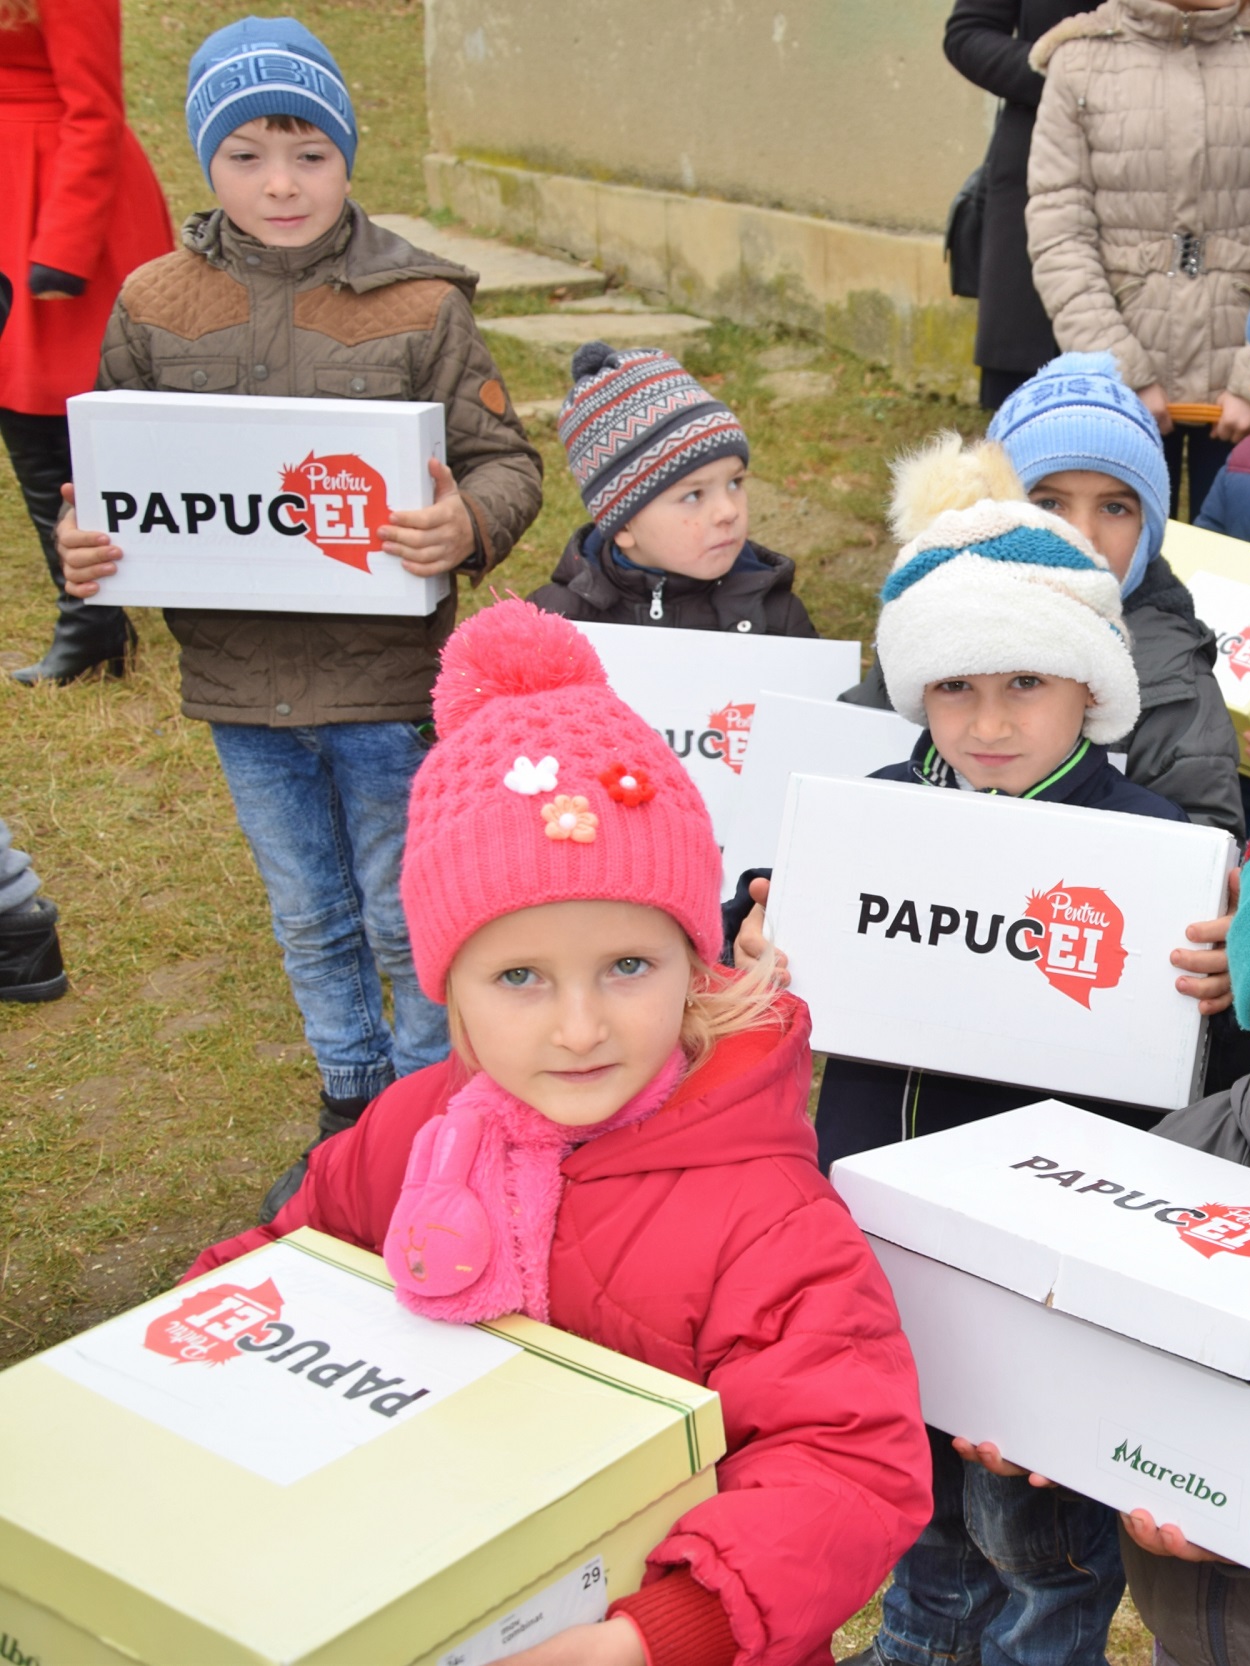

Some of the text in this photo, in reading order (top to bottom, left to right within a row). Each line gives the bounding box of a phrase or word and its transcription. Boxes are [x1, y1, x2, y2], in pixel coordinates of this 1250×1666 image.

[301, 463, 372, 492] Pentru
[1047, 891, 1111, 928] Pentru
[165, 1320, 219, 1360] Pentru
[1111, 1438, 1227, 1508] Marelbo
[582, 1567, 600, 1590] 29
